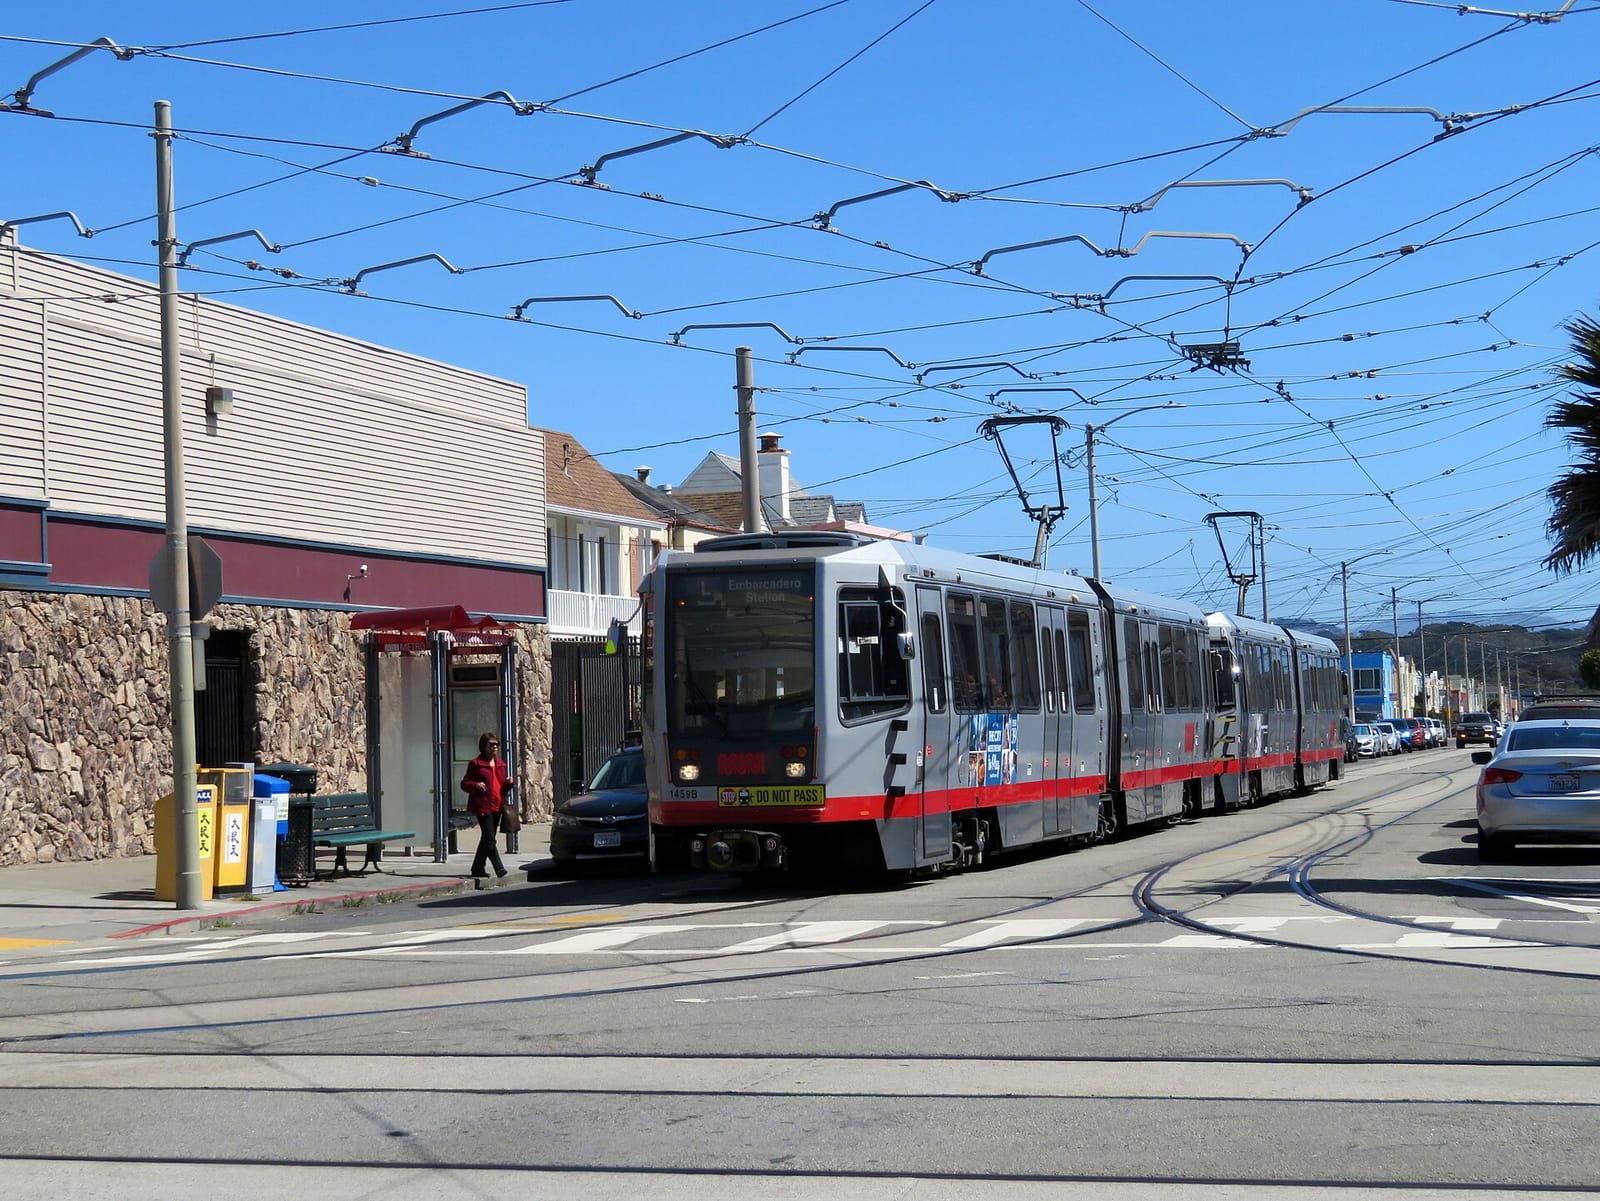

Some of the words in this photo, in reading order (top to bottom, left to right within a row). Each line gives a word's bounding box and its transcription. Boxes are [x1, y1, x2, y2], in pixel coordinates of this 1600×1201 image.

[728, 578, 801, 591] Embarcadero
[745, 592, 785, 602] Station
[669, 790, 697, 799] 1459B
[721, 791, 736, 801] STOP
[756, 791, 769, 802] DO
[772, 790, 791, 802] NOT
[794, 789, 818, 801] PASS
